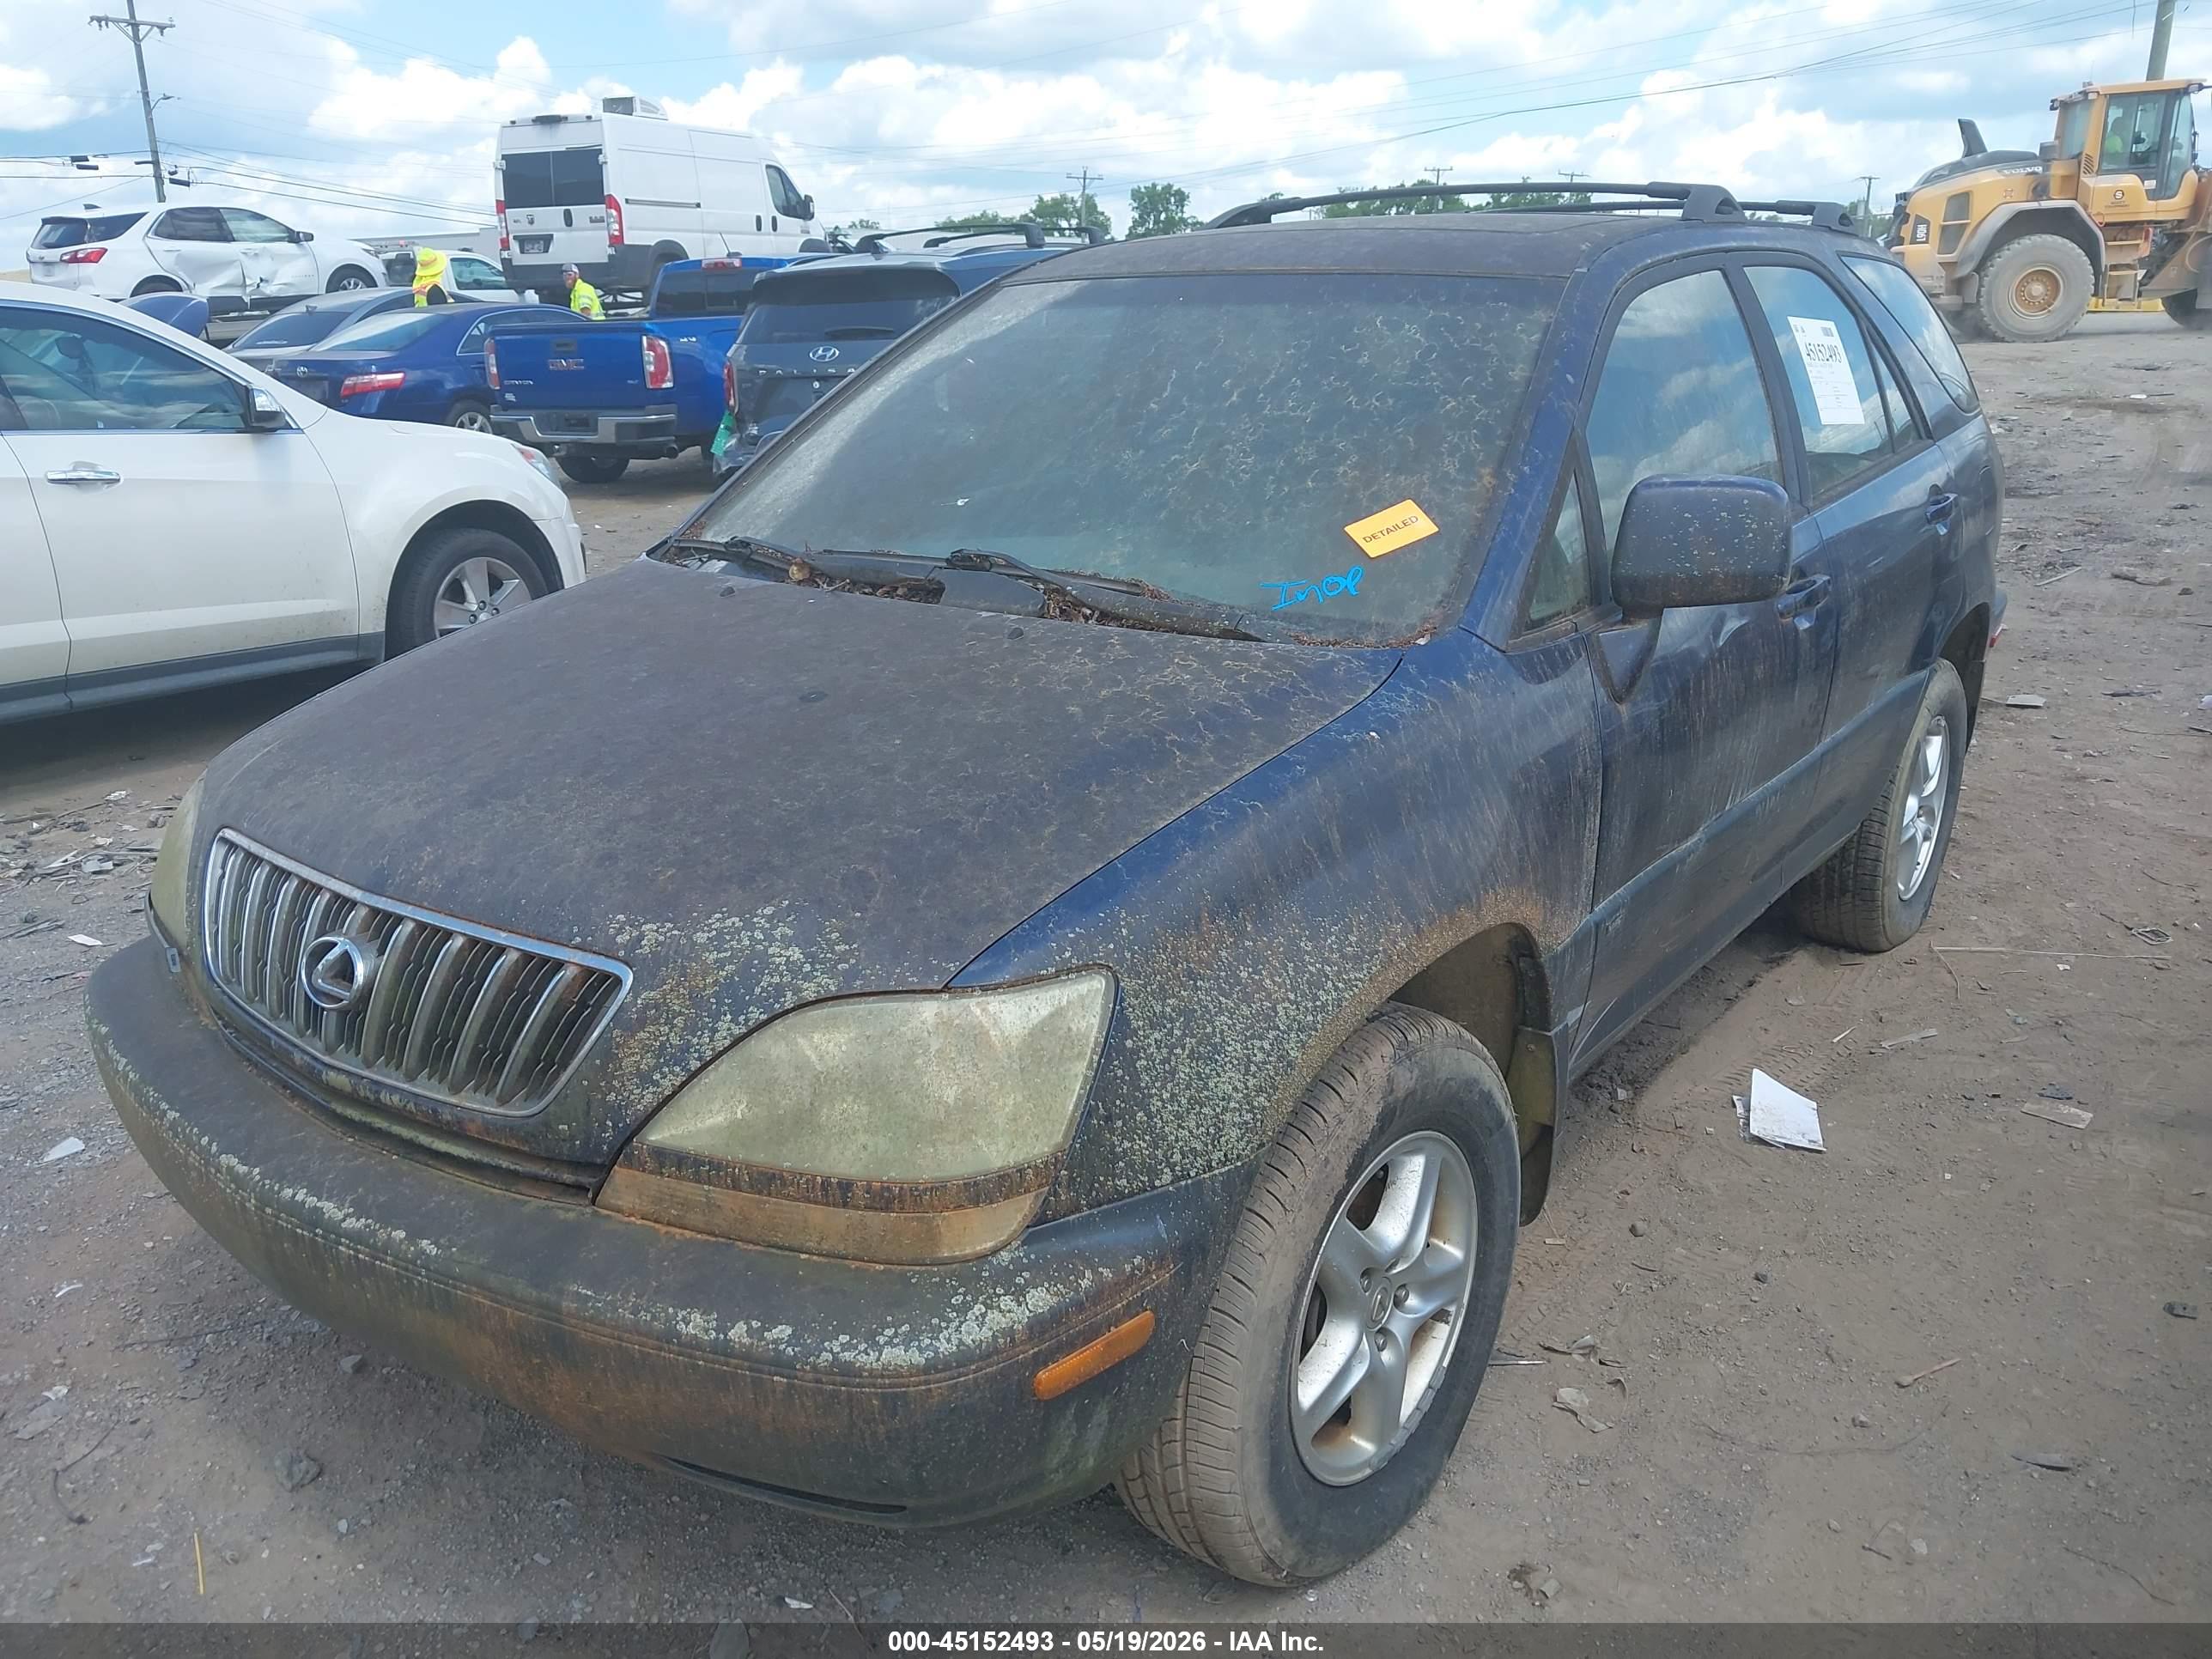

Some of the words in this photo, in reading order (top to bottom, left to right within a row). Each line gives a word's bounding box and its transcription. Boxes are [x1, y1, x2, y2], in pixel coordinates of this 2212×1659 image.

[2003, 166, 2043, 175] VOLVO
[1916, 224, 1928, 242] L90H
[1805, 343, 1842, 363] 45152493
[548, 358, 585, 370] GMC
[1363, 515, 1419, 543] DETAILED
